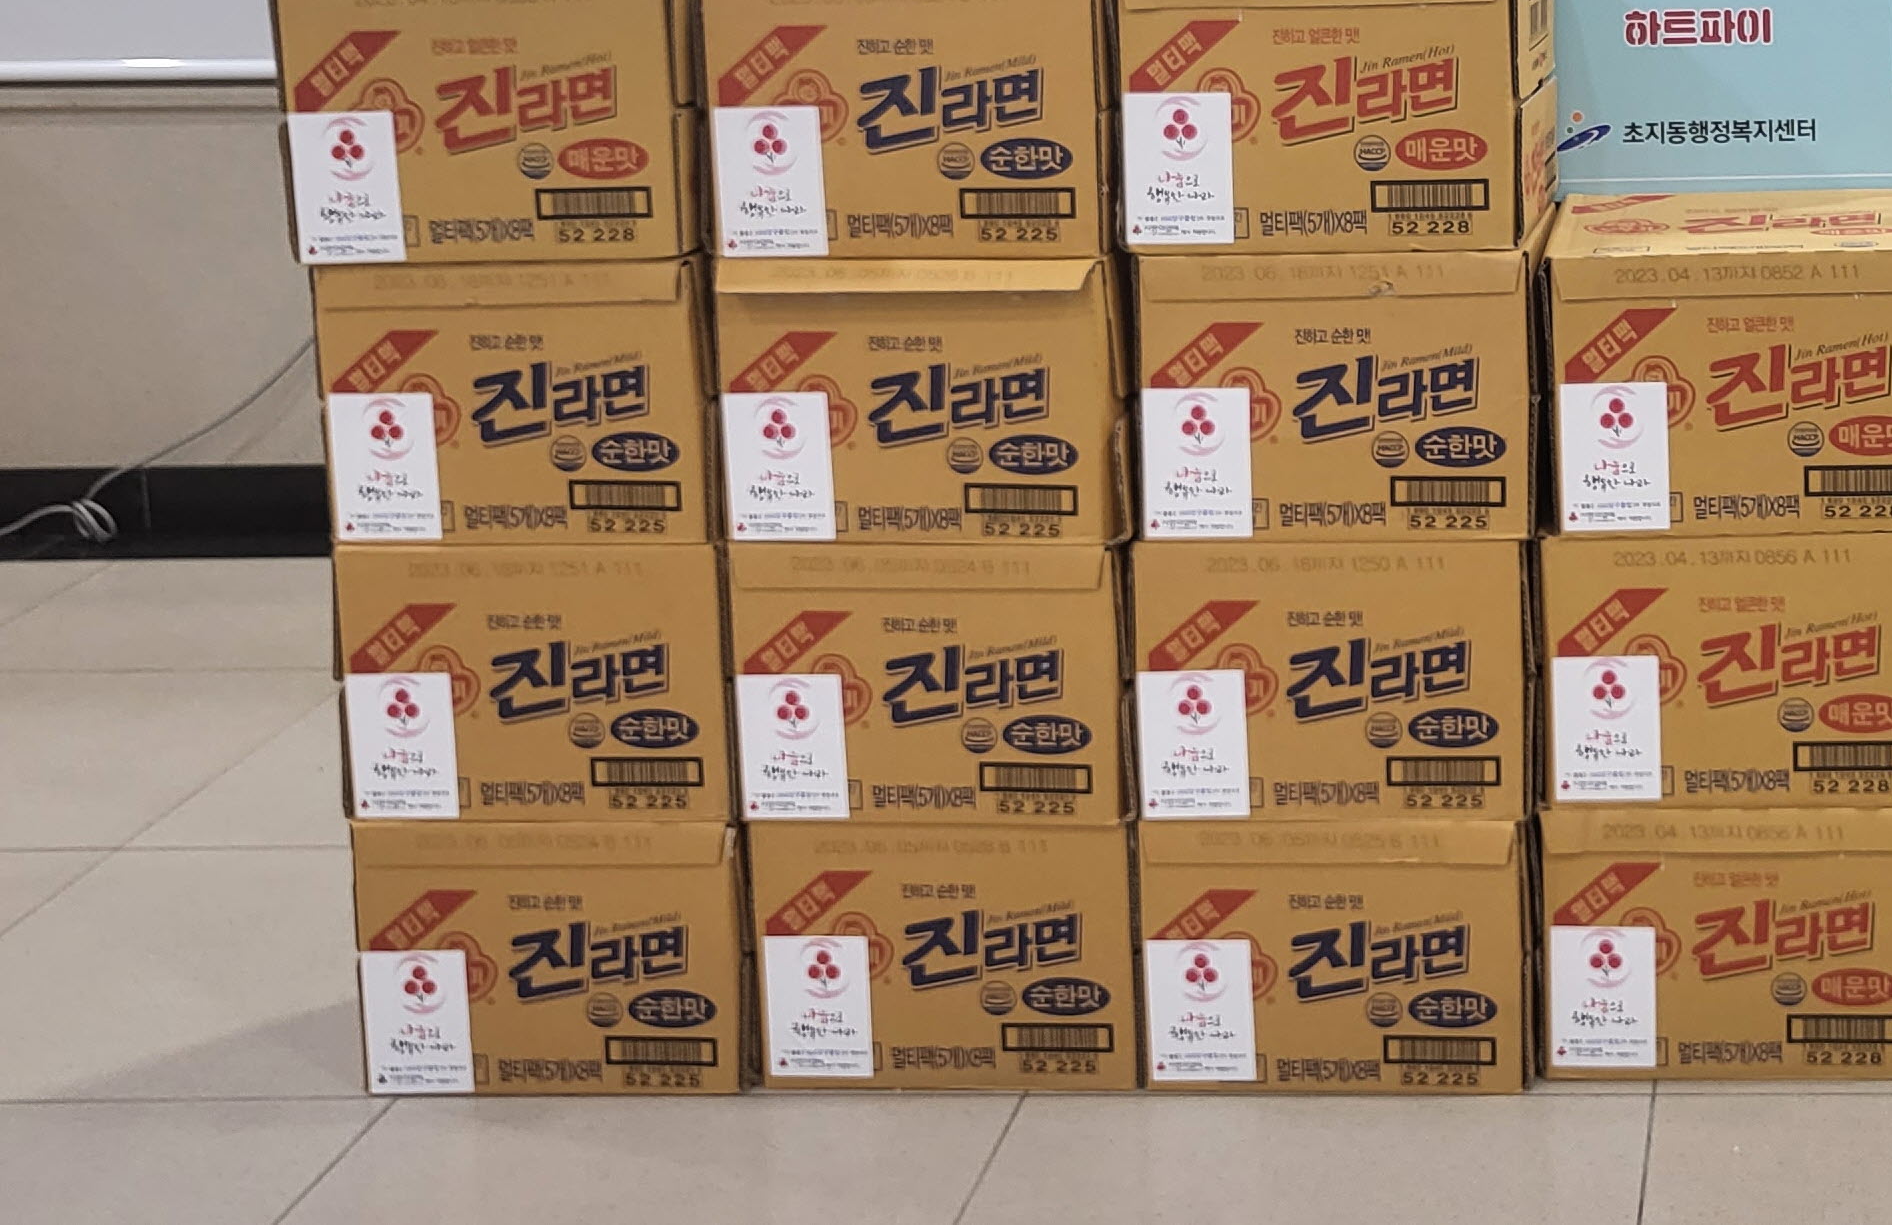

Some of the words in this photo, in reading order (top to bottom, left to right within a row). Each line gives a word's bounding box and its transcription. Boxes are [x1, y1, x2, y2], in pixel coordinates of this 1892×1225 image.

[1624, 8, 1771, 45] 하트파이
[1360, 59, 1379, 74] Jin
[435, 65, 616, 155] 진라면
[856, 67, 1042, 151] 진라면
[1271, 56, 1458, 145] 진라면
[1622, 118, 1817, 145] 초지동행정복지센터
[565, 143, 641, 173] 매운맛
[989, 144, 1067, 173] 순한맛
[1358, 146, 1387, 157] HACCP
[1403, 134, 1480, 164] 매운맛
[1292, 356, 1481, 442] 진라면
[1706, 344, 1892, 431] 진라면
[472, 363, 649, 446] 진라면
[868, 366, 1050, 448] 진라면
[598, 438, 673, 465] 순한맛
[996, 440, 1071, 468] 순한맛
[1423, 433, 1499, 461] 순한맛
[489, 642, 668, 721] 진라면
[1288, 639, 1469, 720] 진라면
[1697, 624, 1882, 708] 진라면
[883, 647, 1063, 726] 진라면
[617, 715, 693, 743] 순한맛
[1010, 721, 1085, 750] 순한맛
[1416, 714, 1492, 742] 순한맛
[902, 911, 1081, 987] 진라면
[1692, 900, 1874, 981] 진라면
[509, 924, 688, 1003] 진라면
[1288, 923, 1471, 1003] 진라면
[1029, 982, 1104, 1011] 순한맛
[1819, 973, 1892, 1000] 매운맛
[635, 996, 710, 1023] 순한맛
[1415, 995, 1490, 1022] 순한맛
